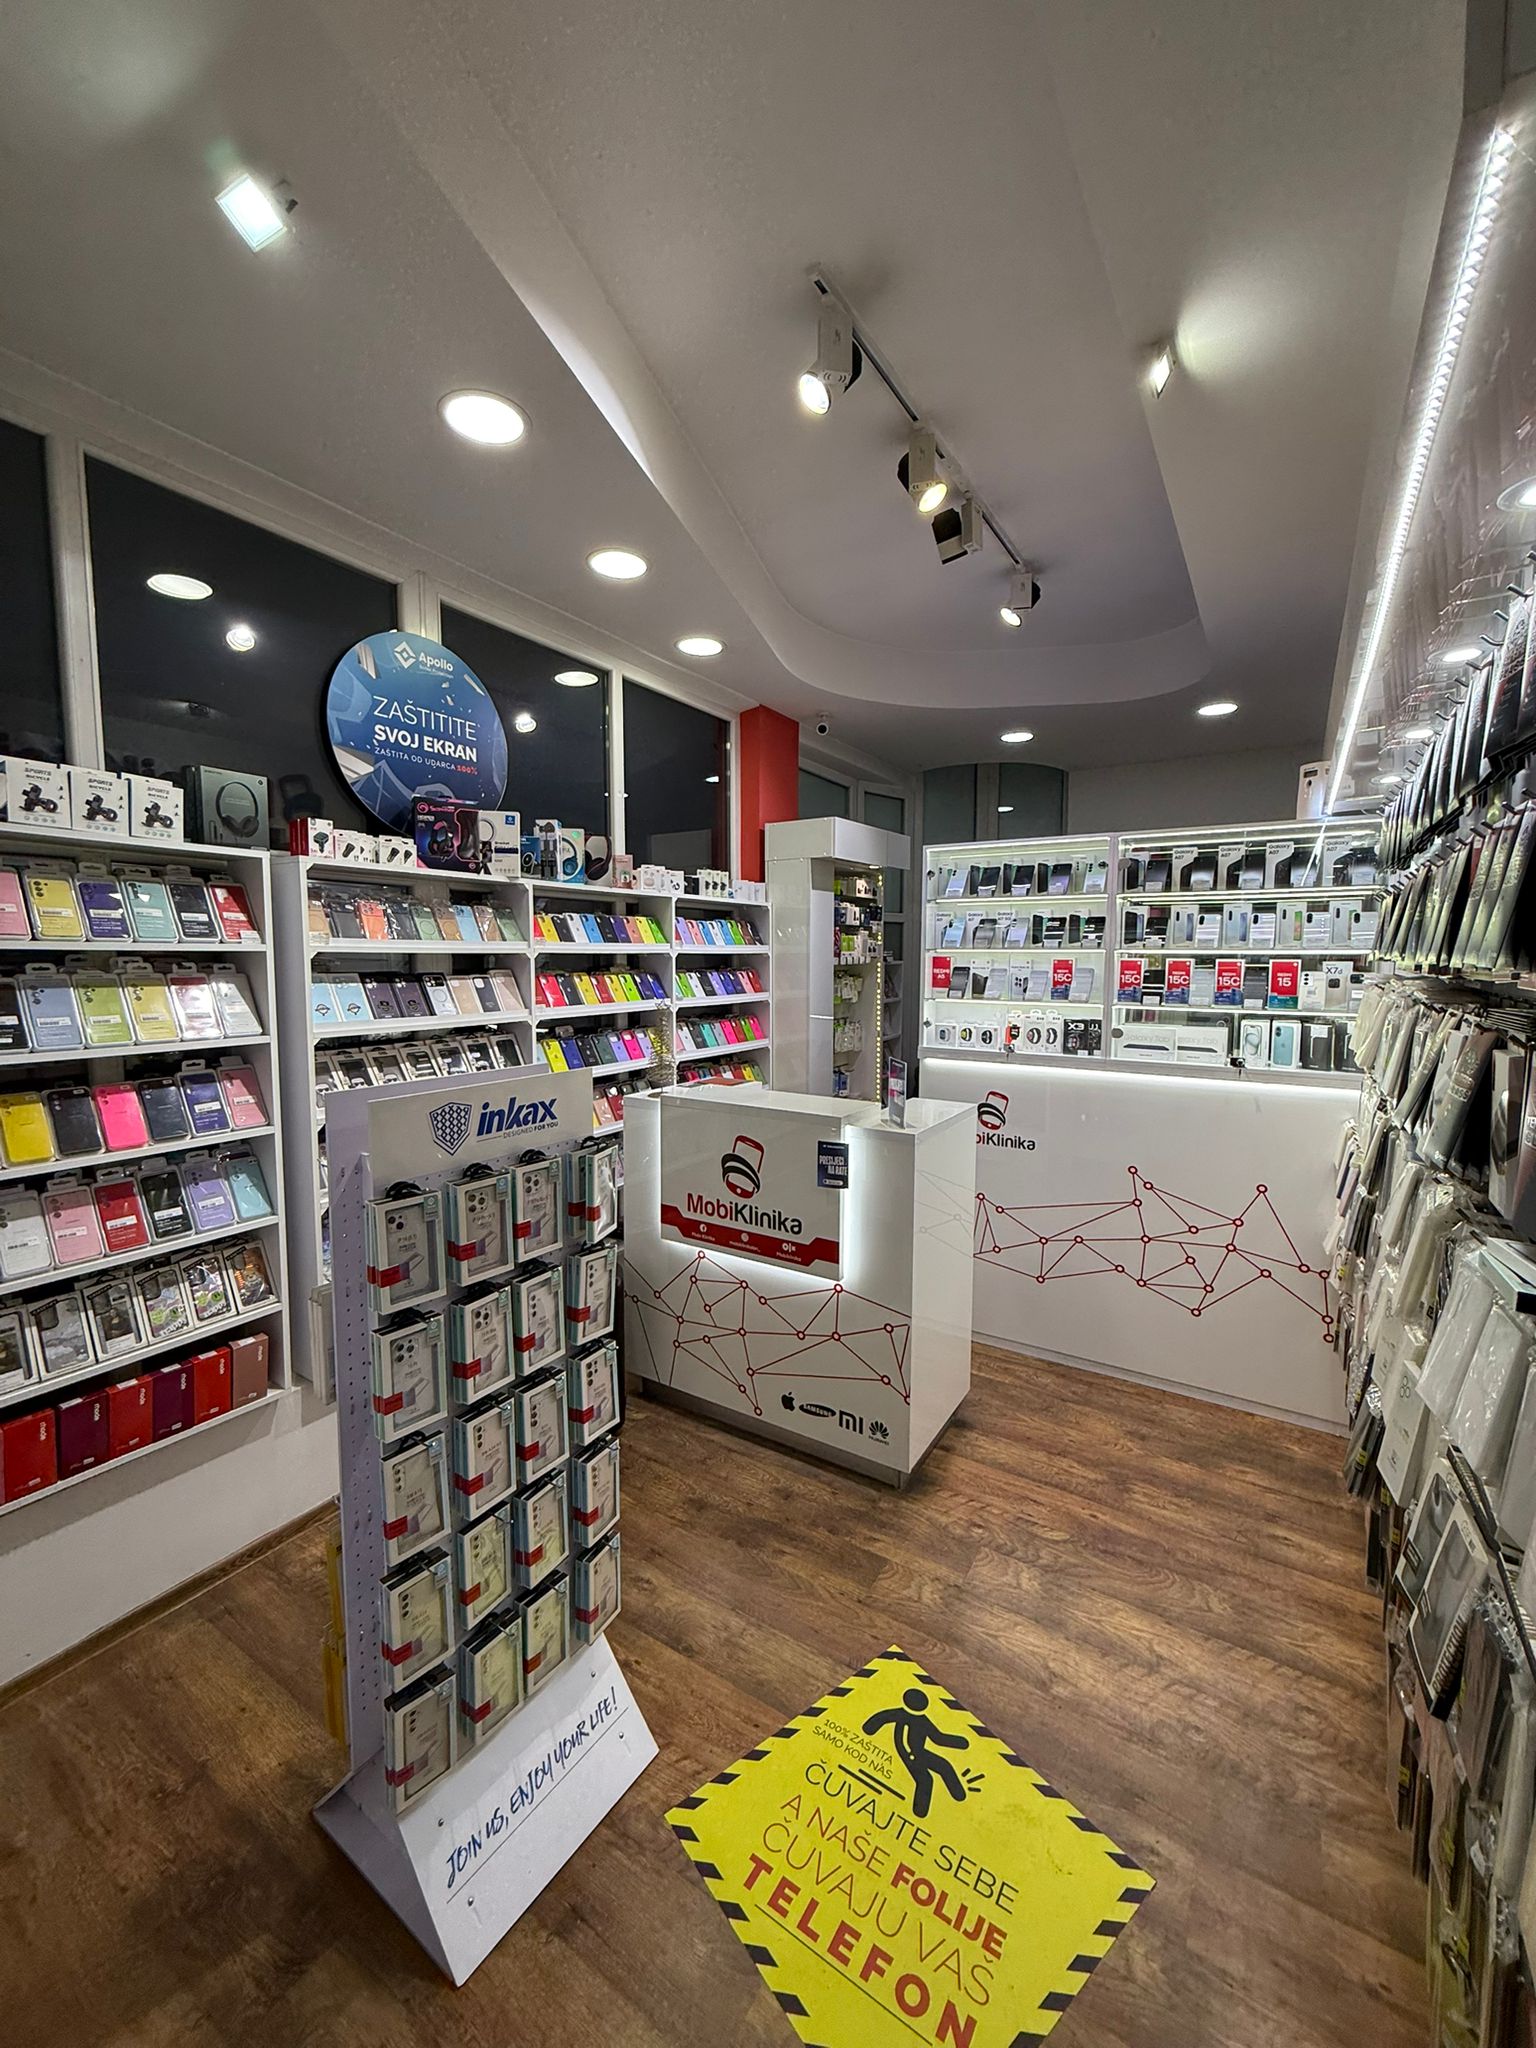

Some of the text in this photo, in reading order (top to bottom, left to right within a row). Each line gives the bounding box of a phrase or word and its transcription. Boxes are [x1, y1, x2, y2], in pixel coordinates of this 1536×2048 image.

[419, 652, 453, 671] Apollo
[373, 696, 477, 741] ZAŠTITITE
[374, 724, 478, 762] SVOJ EKRAN
[375, 747, 478, 776] ZAŠTITA OD UDARCA 100%
[1054, 973, 1072, 982] 15C
[1120, 974, 1141, 984] 15C
[1168, 975, 1190, 985] 15C
[1218, 976, 1240, 986] 15C
[1277, 977, 1292, 986] 15
[1067, 1022, 1085, 1031] X3
[477, 1096, 557, 1137] inkax
[503, 1121, 559, 1138] DESIGNED FOR YOU
[687, 1193, 803, 1235] MobiKlinika
[812, 1725, 894, 1780] SAMO KOD NAS
[824, 1719, 893, 1765] 100% ZAŠTITA
[446, 1830, 482, 1889] JOIN
[510, 1753, 554, 1815] ENJOY
[555, 1721, 589, 1769] YOUR
[590, 1686, 618, 1730] LIFE!
[805, 1759, 1019, 1915] ČUVAJTE SEBE
[780, 1794, 1008, 1960] A NAŠE FOLIJE
[763, 1816, 995, 2006] ČUVAJU VAŠ
[743, 1852, 978, 2048] TELEFON
